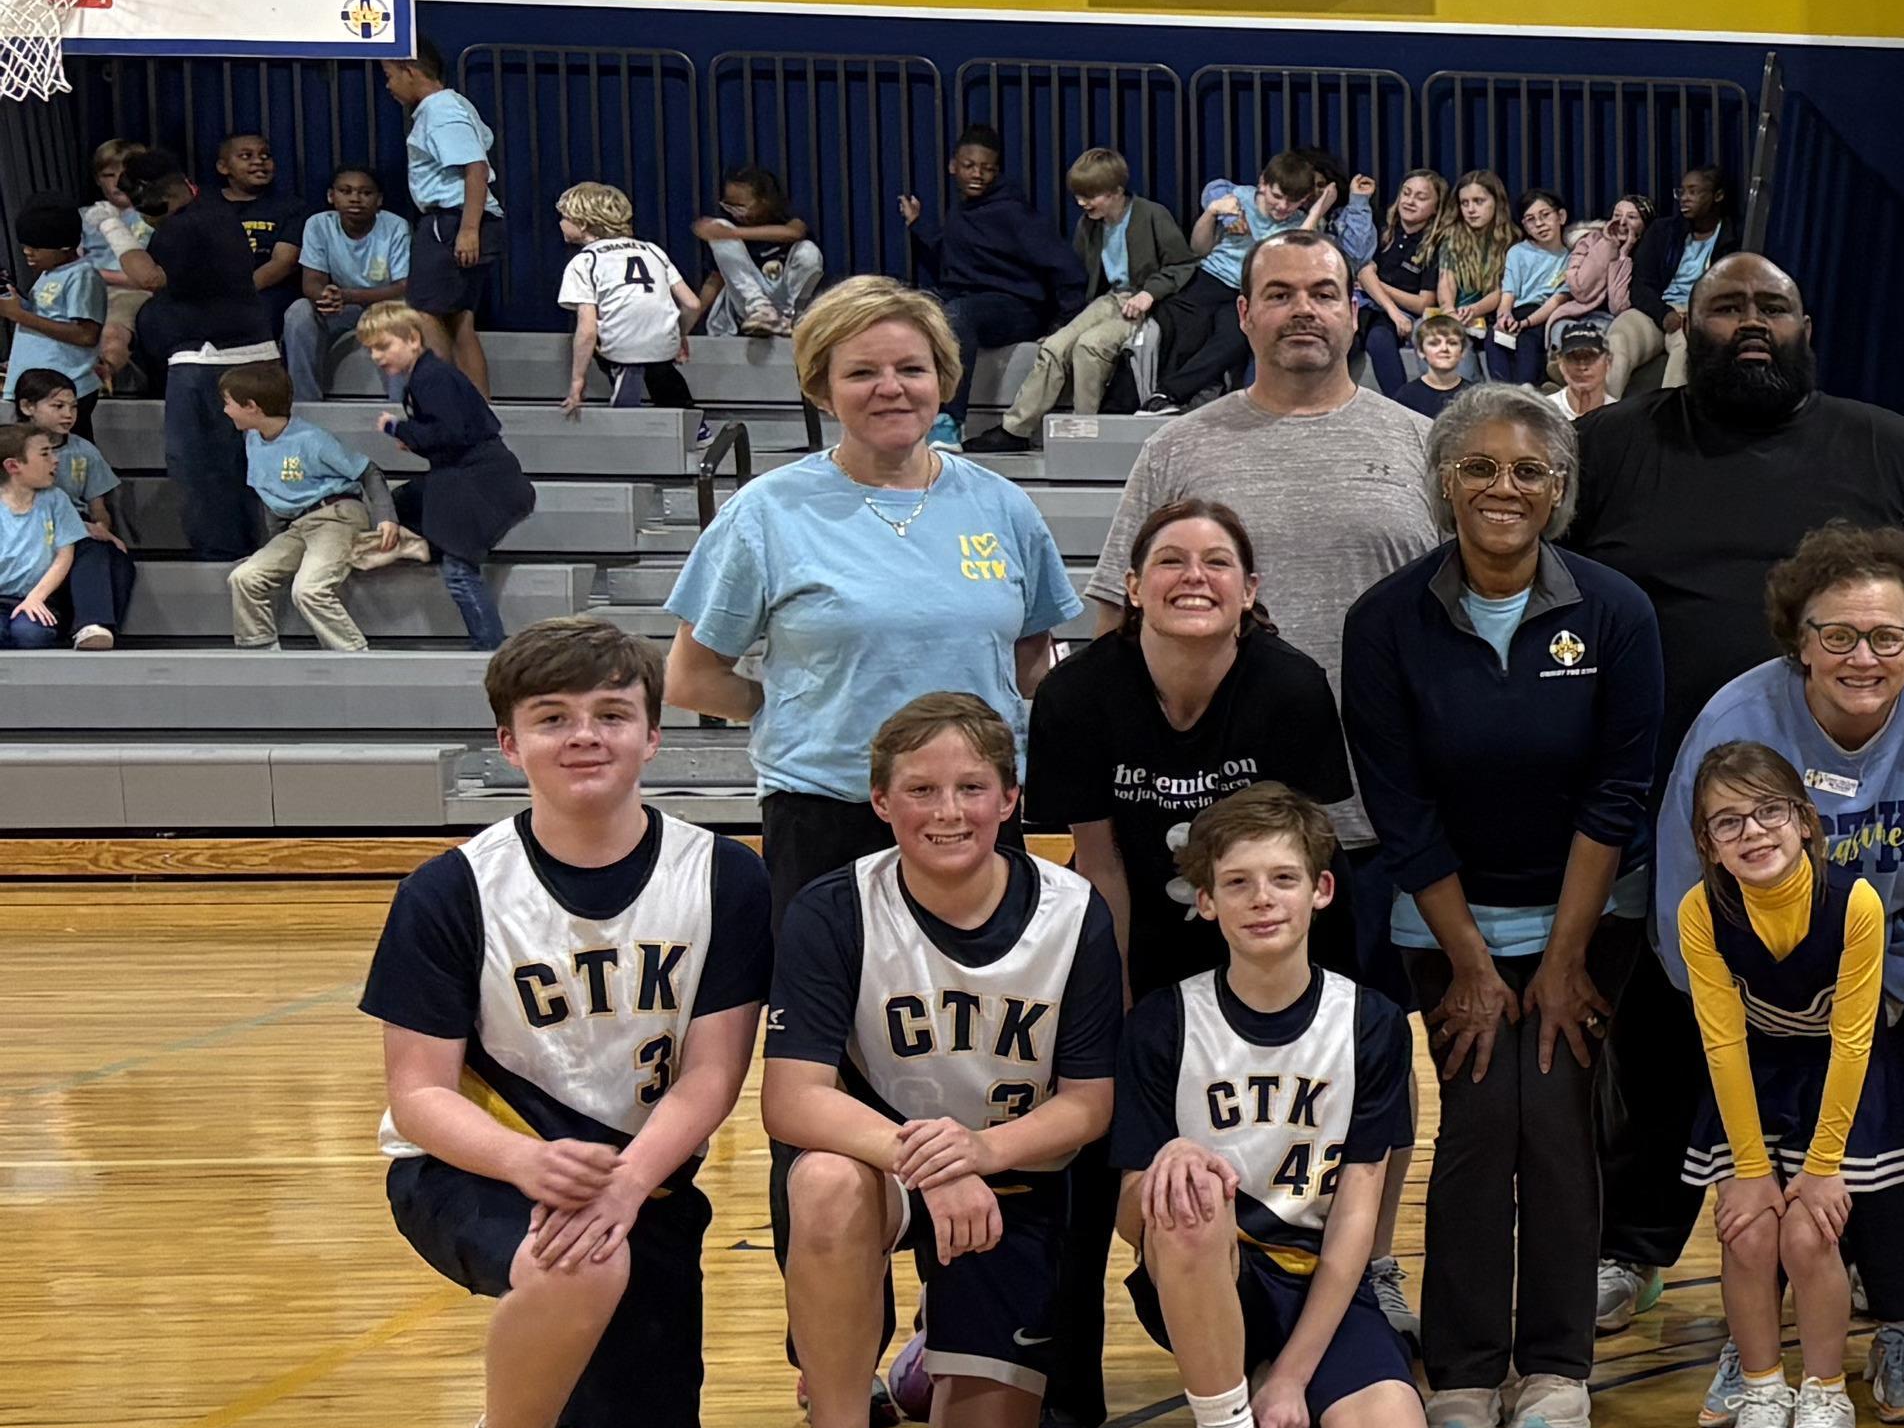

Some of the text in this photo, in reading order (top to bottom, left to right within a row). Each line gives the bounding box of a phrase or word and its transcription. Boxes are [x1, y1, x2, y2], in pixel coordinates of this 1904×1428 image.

[625, 256, 655, 293] 4
[1113, 764, 1146, 785] he
[512, 942, 690, 1029] CTK
[885, 989, 1055, 1063] CTK
[1205, 1075, 1330, 1132] CTK
[1271, 1141, 1344, 1198] 42
